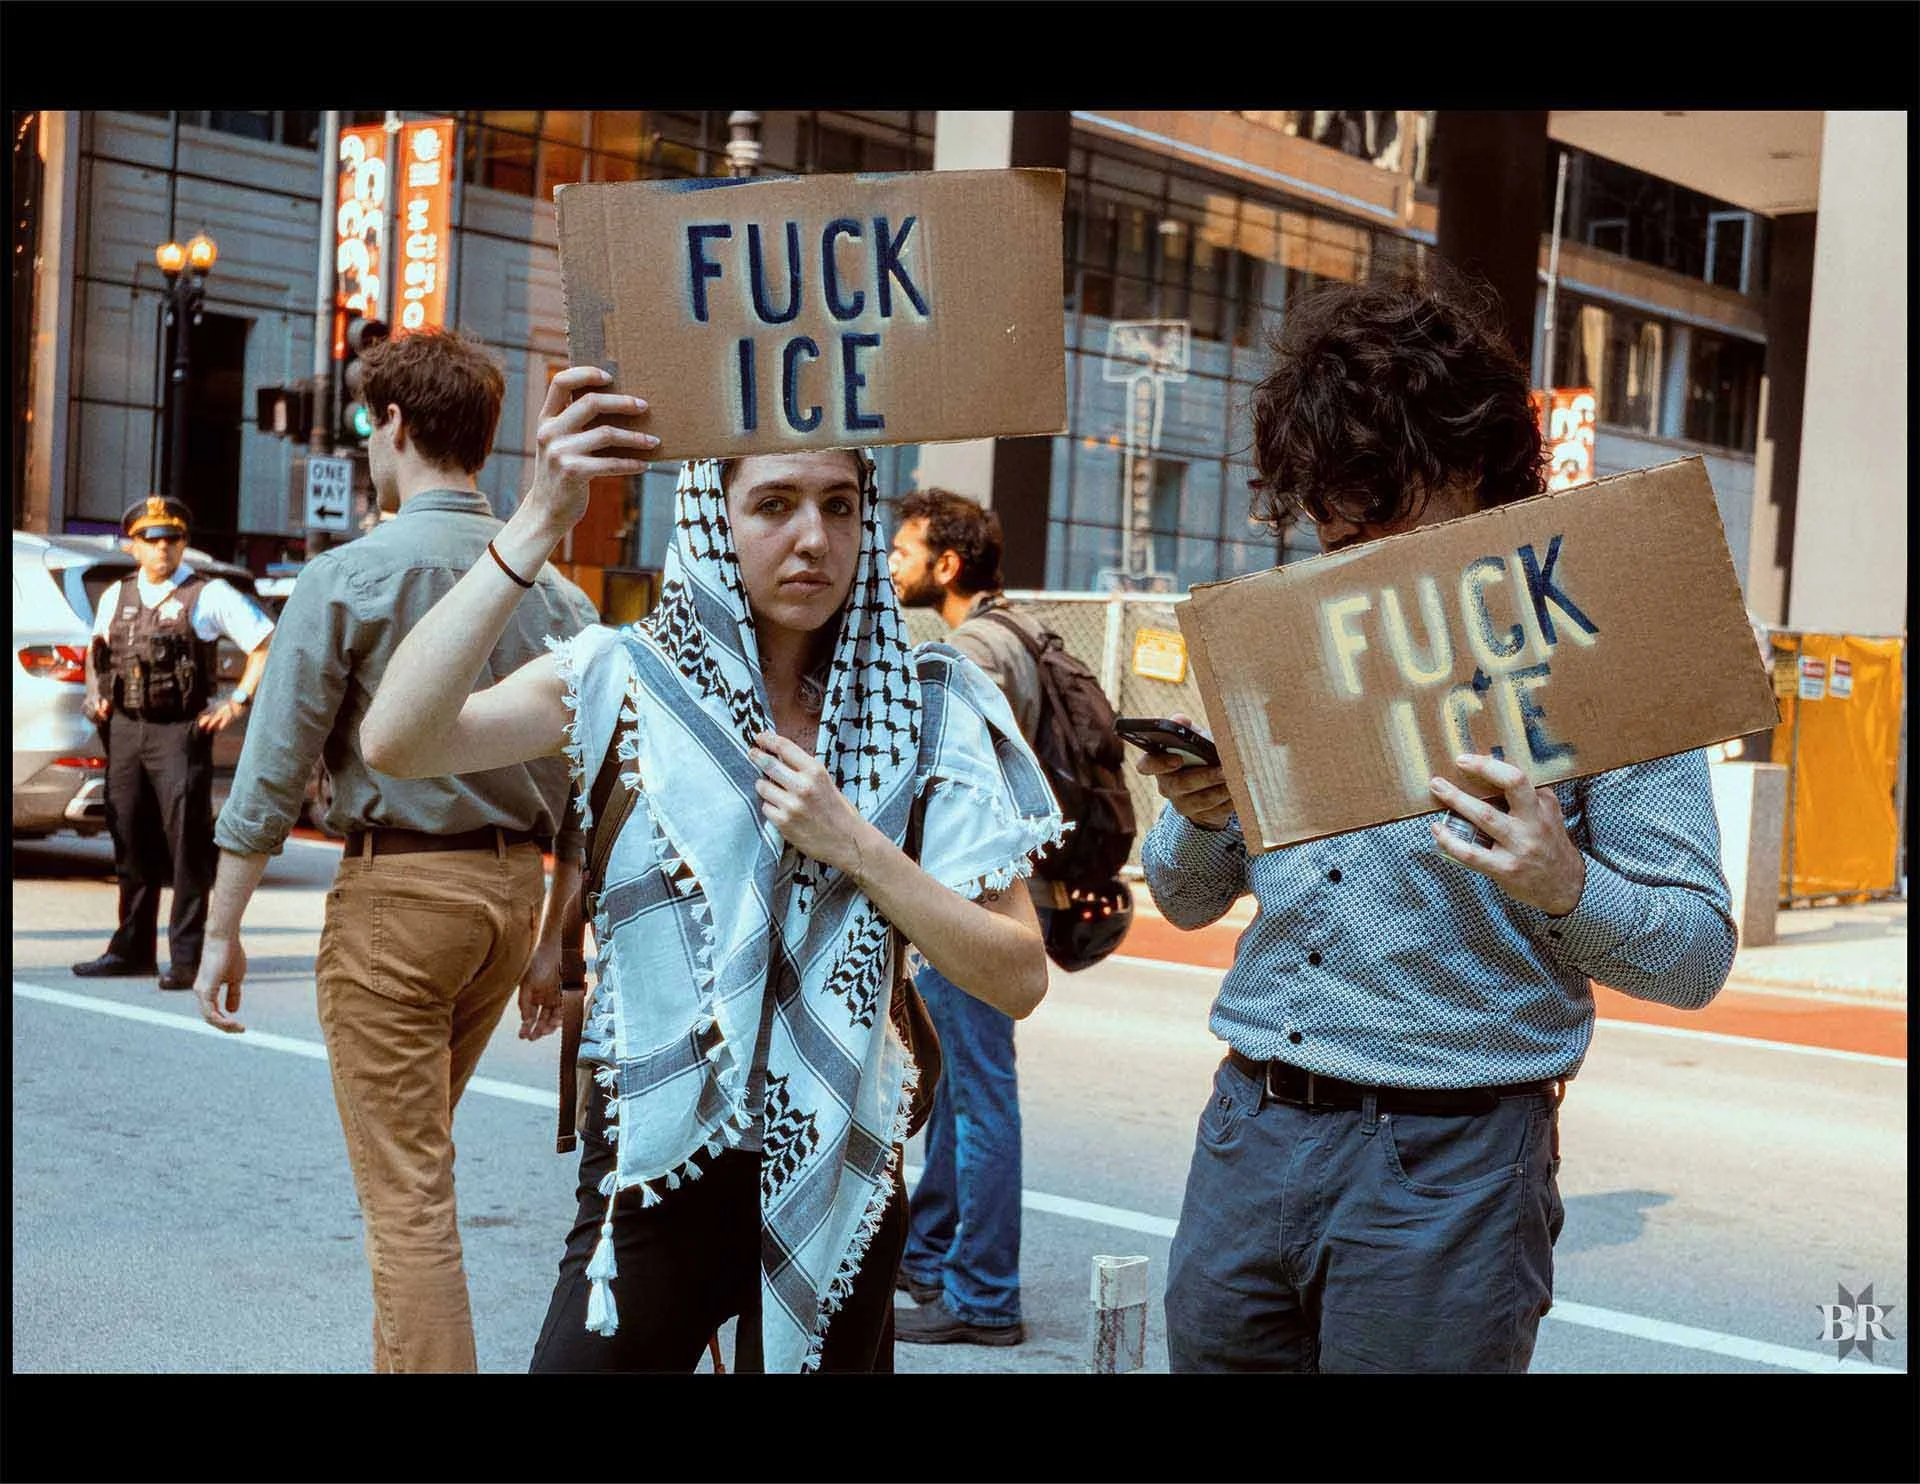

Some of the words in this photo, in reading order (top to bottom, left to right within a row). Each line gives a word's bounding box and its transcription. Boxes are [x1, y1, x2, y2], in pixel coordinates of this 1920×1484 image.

[686, 215, 931, 325] FUCK
[737, 333, 887, 434] ICE
[312, 463, 346, 481] ONE
[312, 483, 346, 500] WAY
[1321, 534, 1600, 698] FUCK
[1390, 662, 1577, 803] ICE
